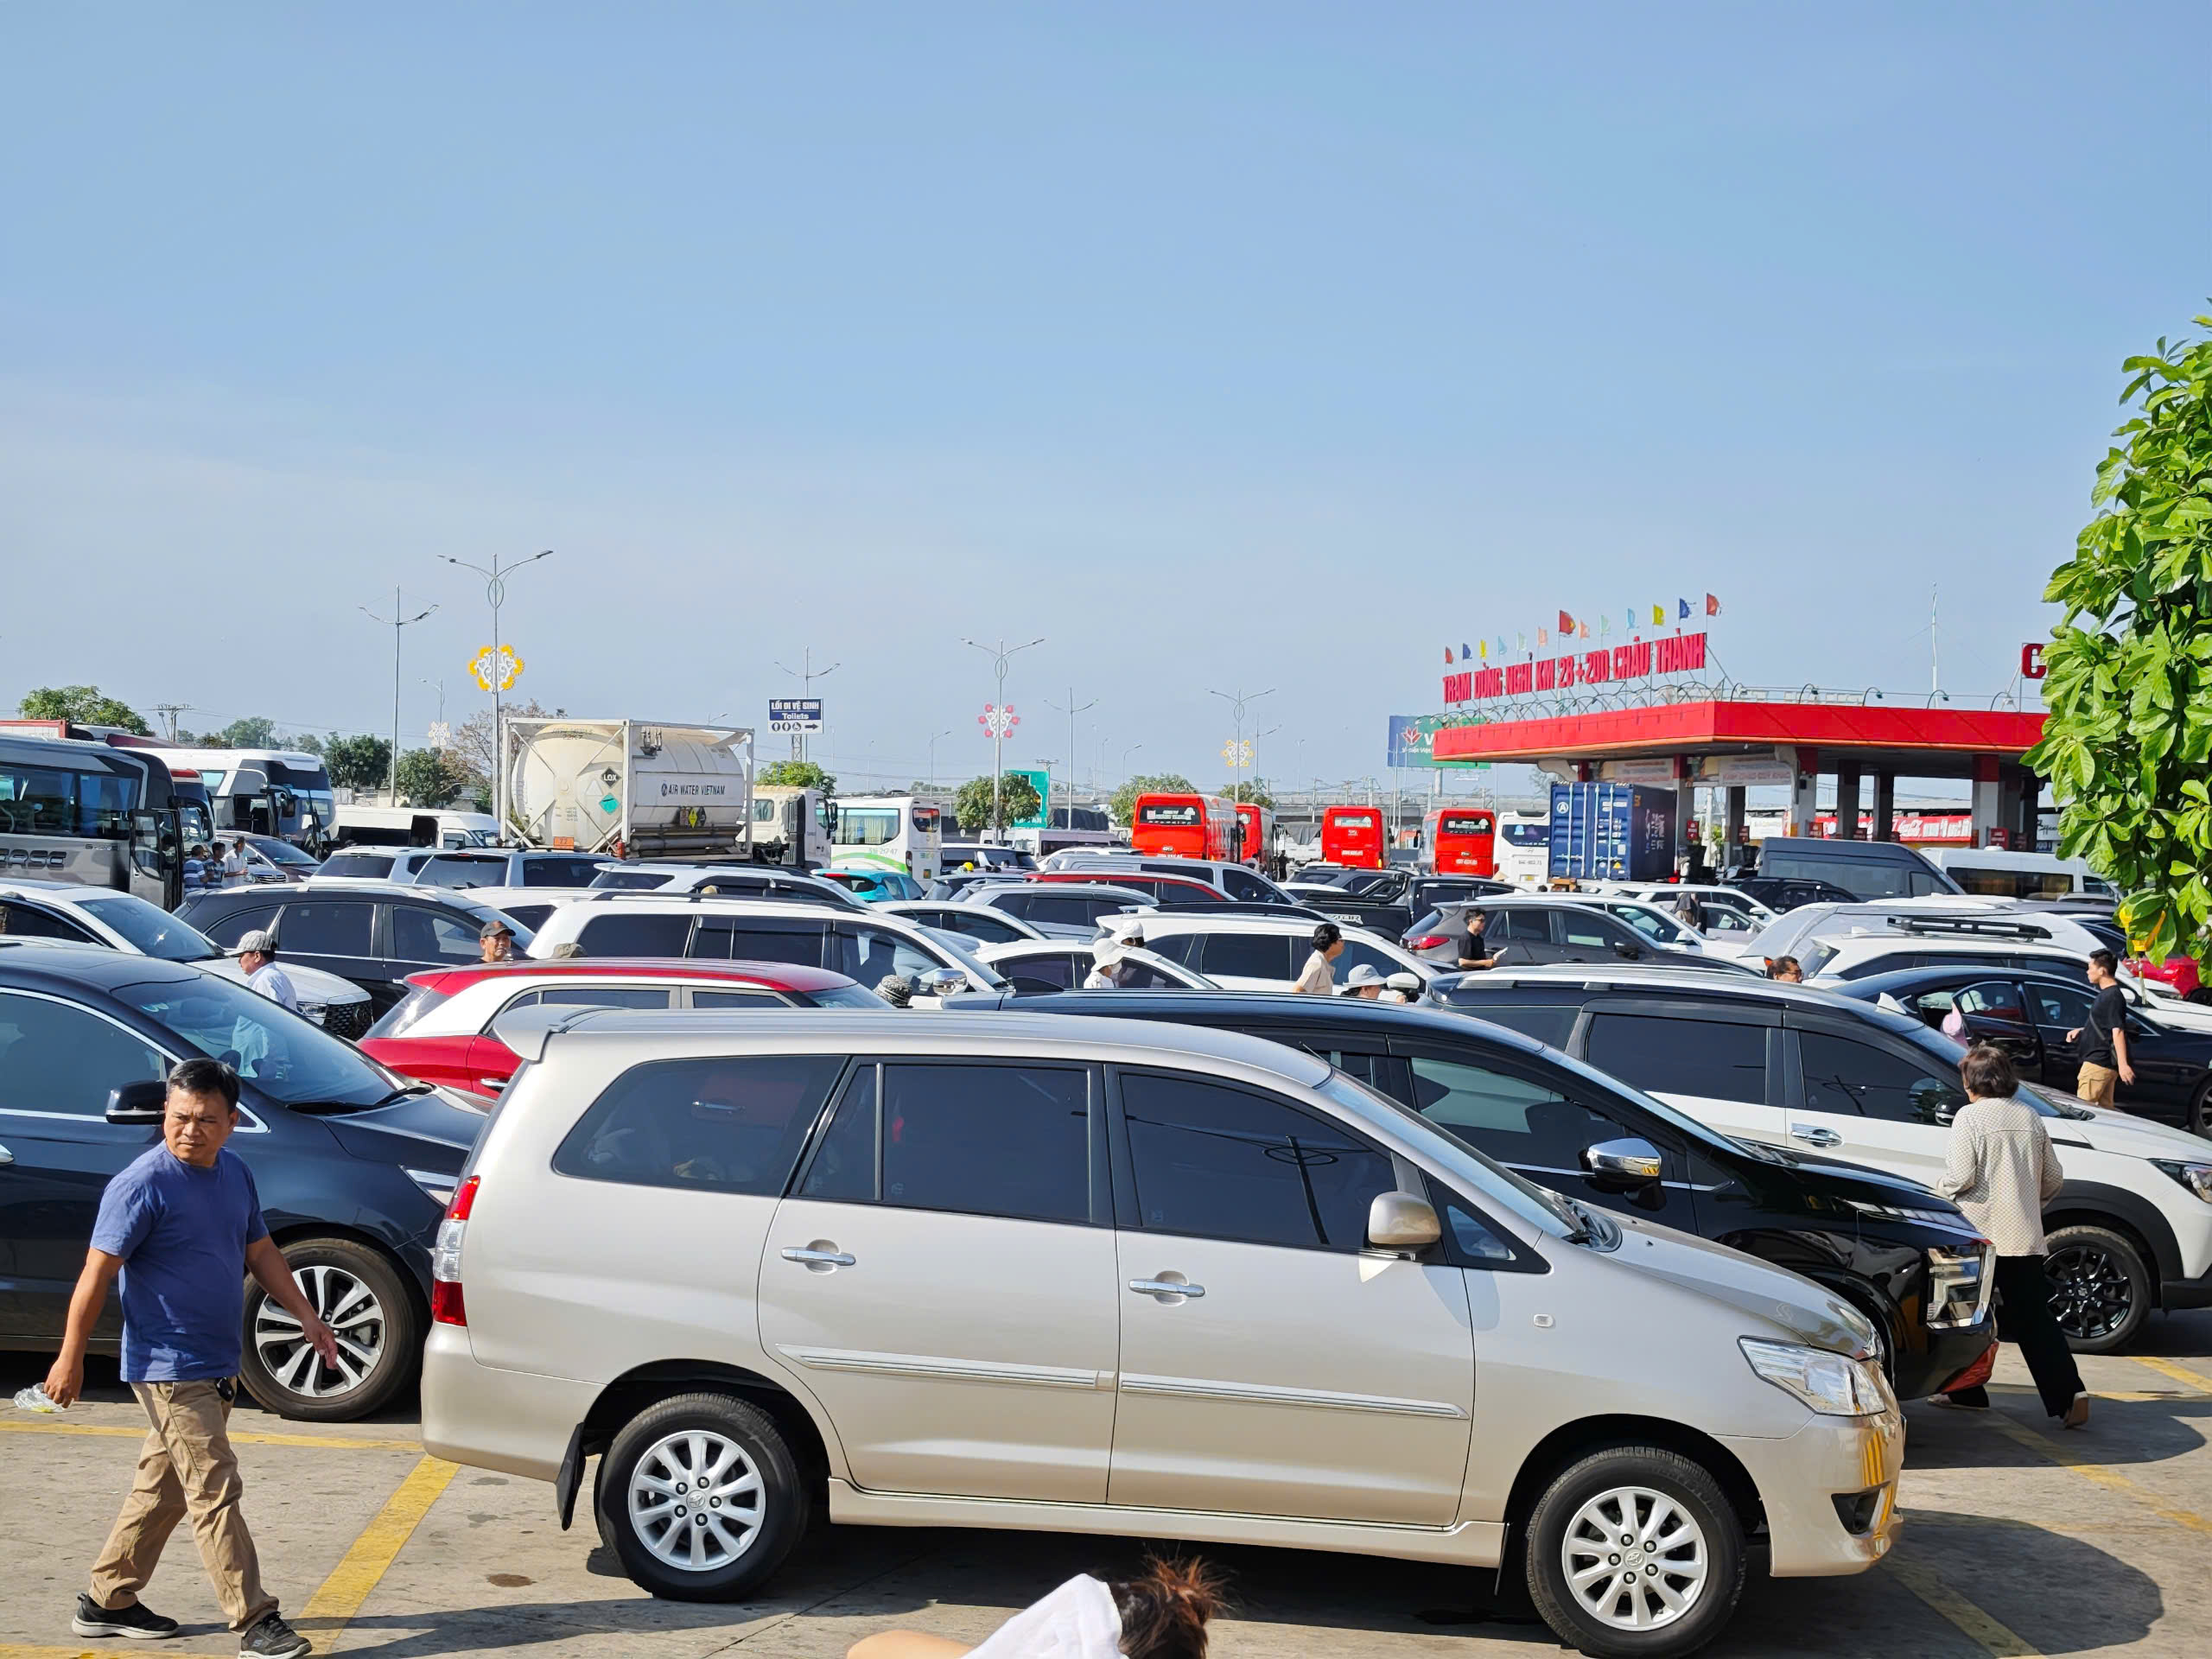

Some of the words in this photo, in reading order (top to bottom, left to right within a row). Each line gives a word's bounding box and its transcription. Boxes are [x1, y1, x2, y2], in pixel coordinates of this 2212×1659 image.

[1443, 672, 1471, 708] TRẠM
[1535, 658, 1555, 691] KM
[1613, 636, 1650, 680] CHÂU
[1655, 627, 1706, 674] THÀNH
[802, 701, 819, 710] SINH
[668, 784, 678, 795] AIR
[680, 785, 699, 796] WATER
[701, 785, 726, 796] VIETNAM
